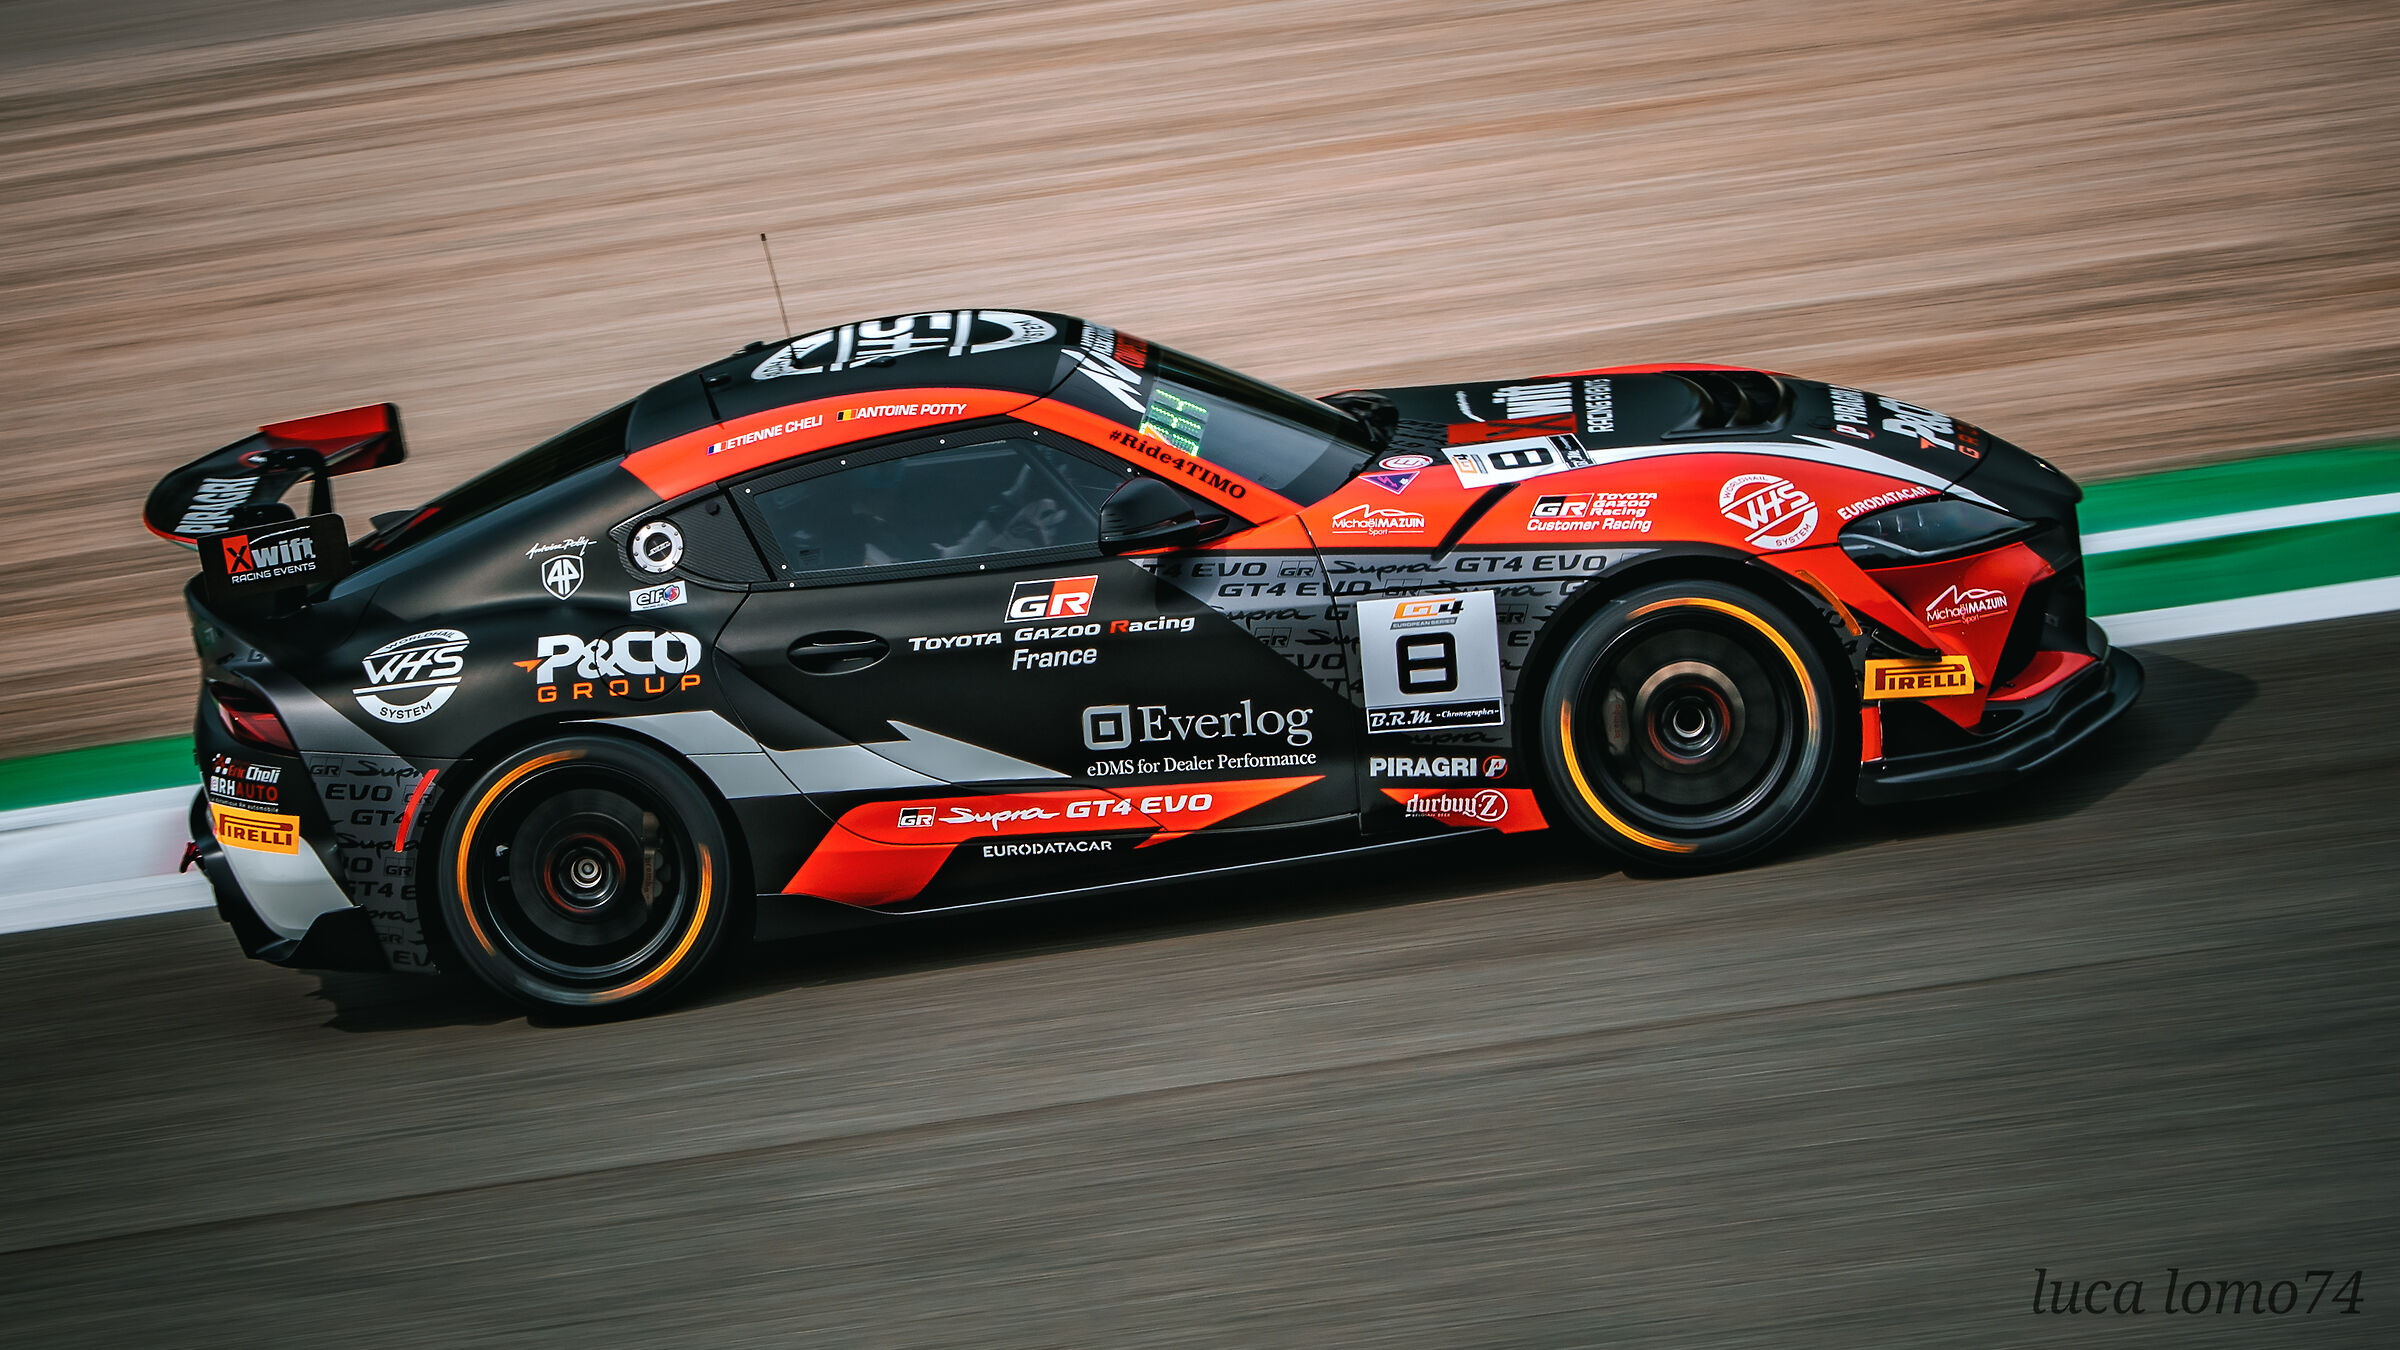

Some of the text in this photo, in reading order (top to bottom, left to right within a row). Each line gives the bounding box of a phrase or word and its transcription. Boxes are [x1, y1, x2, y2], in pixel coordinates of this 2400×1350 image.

[856, 403, 967, 420] ANTOINE POTTY
[727, 414, 823, 450] ETIENNE CHELI
[1109, 430, 1246, 499] #Ride4TIMO
[1592, 500, 1651, 508] GAZOO
[1597, 492, 1658, 501] TOYOTA
[1725, 482, 1810, 530] WHS
[1837, 486, 1931, 520] EURODATACAR
[1534, 502, 1587, 517] GR
[1589, 507, 1648, 518] Racing
[1368, 528, 1389, 537] Sport
[1527, 517, 1653, 533] Customer Racing
[1775, 523, 1812, 547] SYSTEM
[231, 561, 317, 585] RACING EVENTS
[1454, 556, 1523, 573] GT4
[1532, 554, 1608, 571] EVO
[637, 588, 664, 606] elf
[1218, 582, 1286, 597] GT4
[1010, 591, 1091, 618] GR
[1393, 597, 1464, 620] GT4
[908, 616, 1196, 652] TOYOTA GAZOO Racing
[362, 645, 468, 685] WHS
[537, 631, 702, 684] P&CO
[1012, 648, 1098, 671] France
[1396, 631, 1459, 695] 8
[537, 674, 701, 703] GROUP
[1874, 663, 1967, 691] PIRELLI
[379, 701, 432, 719] SYSTEM
[1138, 698, 1314, 747] Everlog
[245, 766, 281, 784] Cheli
[1086, 750, 1317, 778] eDMS for Dealer Performance
[1369, 757, 1477, 777] PIRAGRI
[325, 783, 393, 802] EVO
[902, 793, 1213, 832] GR Supra GT4 EVO
[219, 813, 294, 846] PIRELLI
[983, 840, 1112, 859] EURODATACAR
